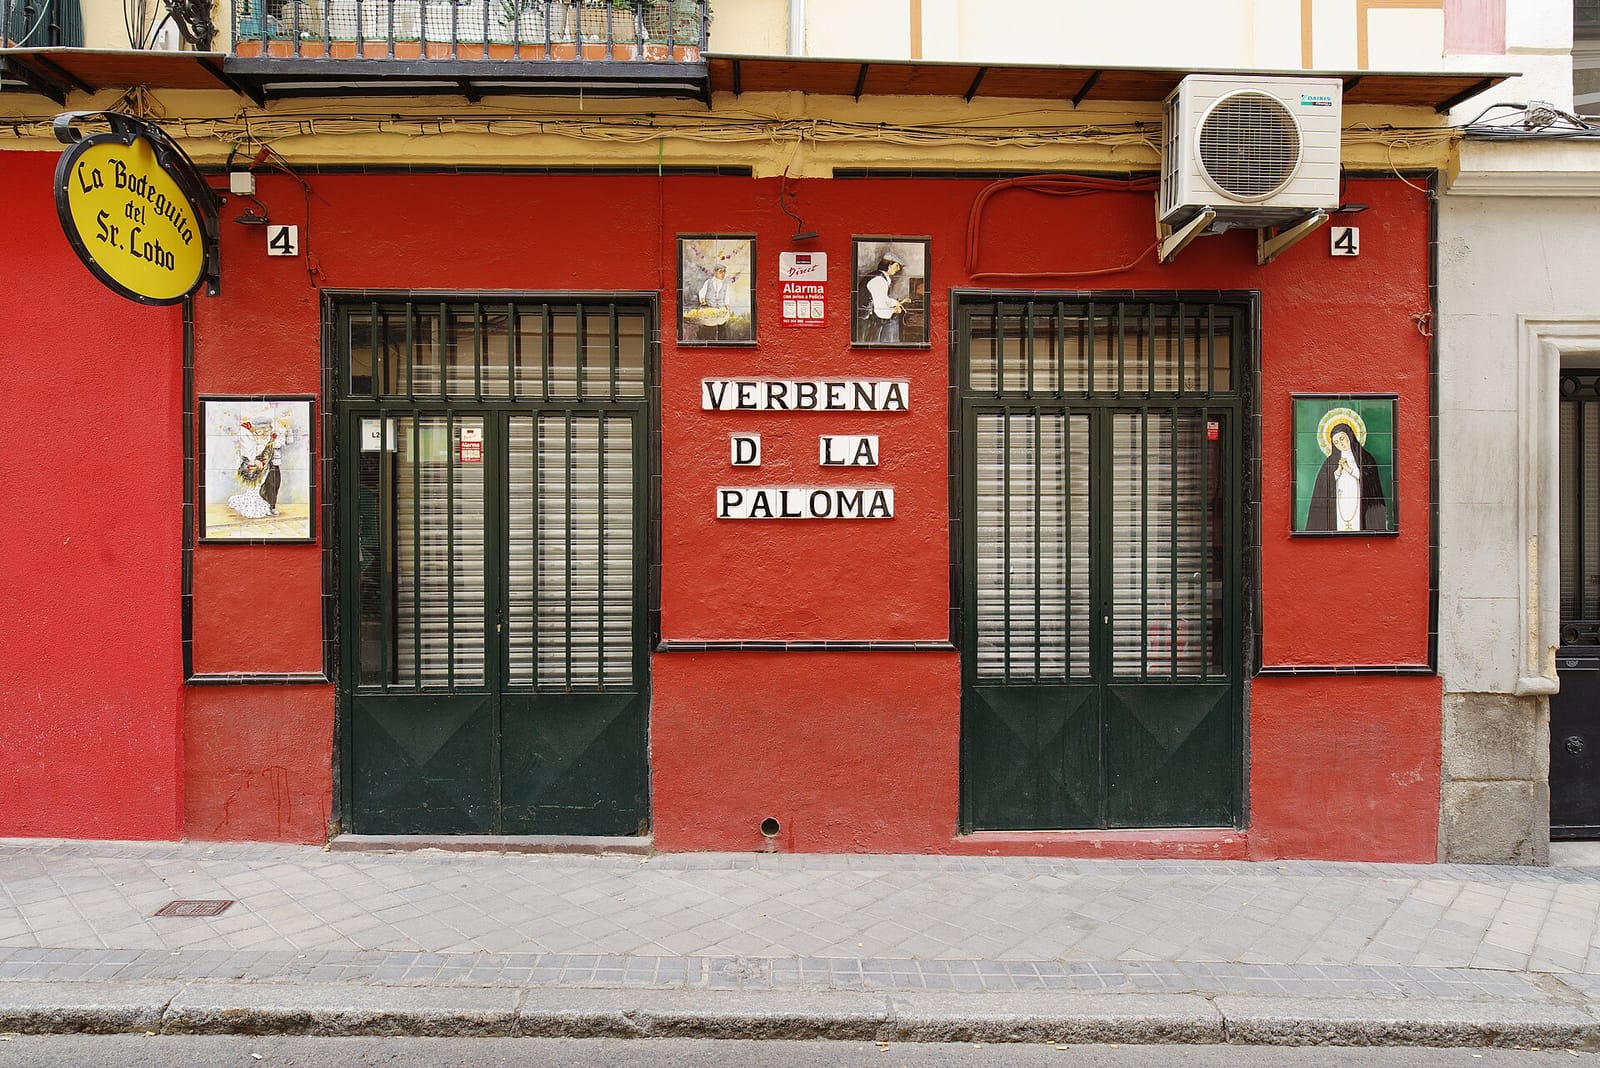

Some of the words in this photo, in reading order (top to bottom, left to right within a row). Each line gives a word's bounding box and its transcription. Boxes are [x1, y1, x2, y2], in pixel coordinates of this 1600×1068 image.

[77, 161, 104, 194] La
[108, 158, 193, 246] Bodeguita
[124, 200, 145, 226] del
[96, 209, 124, 250] Sr.
[130, 226, 175, 272] Lobo
[270, 226, 295, 255] 4
[1334, 227, 1358, 255] 4
[783, 283, 824, 293] Alarma
[704, 381, 907, 410] VERBENA
[733, 437, 758, 465] D
[822, 437, 877, 465] LA
[719, 490, 892, 518] PALOMA
